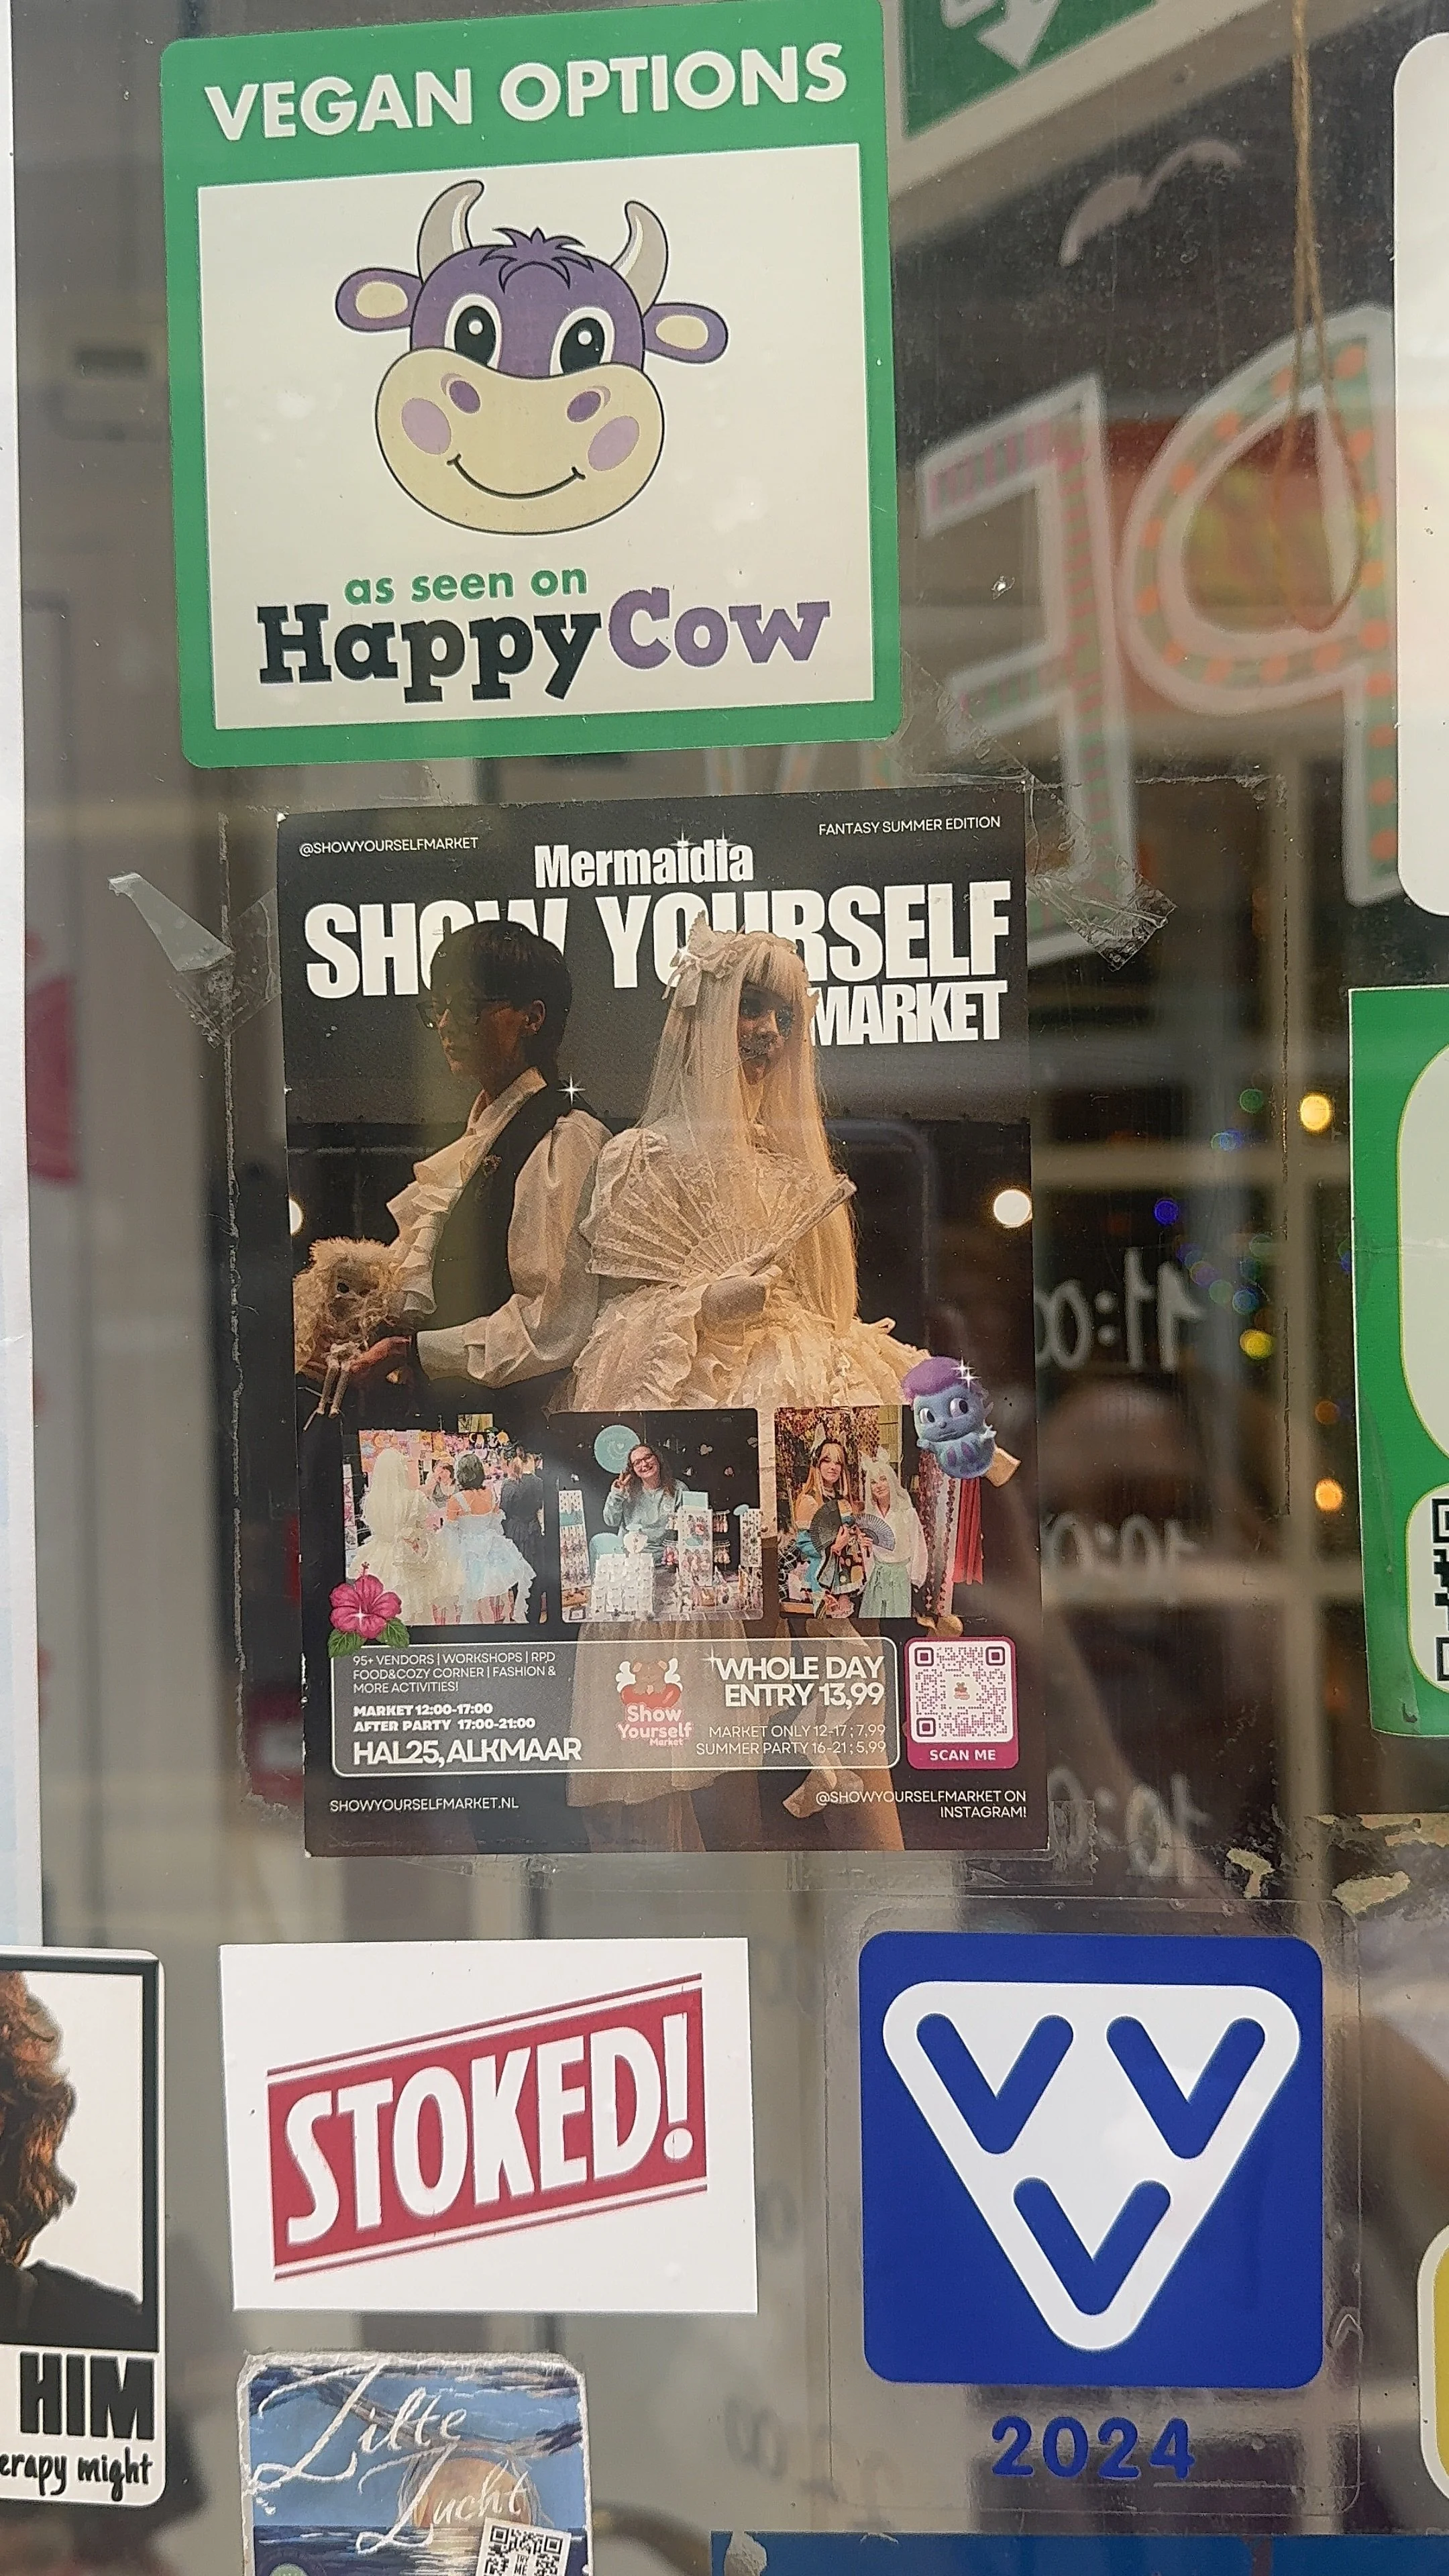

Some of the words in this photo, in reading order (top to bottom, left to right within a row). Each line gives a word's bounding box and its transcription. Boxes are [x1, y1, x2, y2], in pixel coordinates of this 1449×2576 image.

[205, 68, 472, 142] VEGAN
[499, 42, 847, 122] OPTIONS
[344, 578, 395, 606] as
[411, 569, 515, 603] seen
[531, 568, 588, 597] on
[256, 587, 831, 704] HappyCow
[818, 820, 879, 837] FANTASY
[882, 818, 943, 834] SUMMER
[945, 816, 1001, 831] EDITION
[299, 837, 478, 858] @SHOWYOURSELFMARKET
[534, 838, 754, 889] Mermaidia
[305, 897, 568, 1000] SHO
[810, 980, 1008, 1046] MARKET
[353, 1656, 374, 1666] 95+
[376, 1654, 434, 1665] VENDORS
[443, 1652, 522, 1664] WORKSHOPS
[716, 1657, 819, 1680] WHOLE
[826, 1656, 884, 1679] DAY
[353, 1668, 431, 1680] FOOD&COZY
[433, 1667, 484, 1678] CORNER
[493, 1666, 545, 1677] FASHION
[547, 1666, 556, 1676] &
[354, 1682, 389, 1694] MORE
[392, 1682, 458, 1693] ACTIVITIES!
[724, 1684, 816, 1707] ENTRY
[819, 1682, 884, 1710] 13,99
[354, 1705, 413, 1717] MARKET
[415, 1703, 493, 1715] 12:00-17:00
[627, 1705, 682, 1722] Show
[354, 1720, 398, 1733] AFTER
[402, 1719, 451, 1731] PARTY
[458, 1717, 535, 1730] 17:00-21:00
[618, 1722, 692, 1739] Yourself
[709, 1726, 768, 1738] MARKET
[771, 1725, 810, 1738] ONLY
[814, 1725, 847, 1737] 12-17
[858, 1724, 885, 1737] 7,99
[649, 1738, 683, 1746] Market
[696, 1743, 760, 1755] SUMMER
[763, 1743, 808, 1754] PARTY
[812, 1742, 847, 1754] 16-21
[856, 1741, 887, 1755] 5,99
[929, 1750, 969, 1762] SCAN
[975, 1749, 996, 1760] ME
[329, 1797, 519, 1812] SHOWYOURSELFMARKET.NL
[815, 1790, 1001, 1806] @SHOWYOURSELFMARKET
[1004, 1790, 1026, 1803] ON
[940, 1807, 1026, 1819] INSTAGRAM!
[286, 2012, 694, 2248] STOKED!
[20, 2351, 155, 2440] HIM
[991, 2416, 1195, 2479] 2024
[78, 2447, 153, 2502] might
